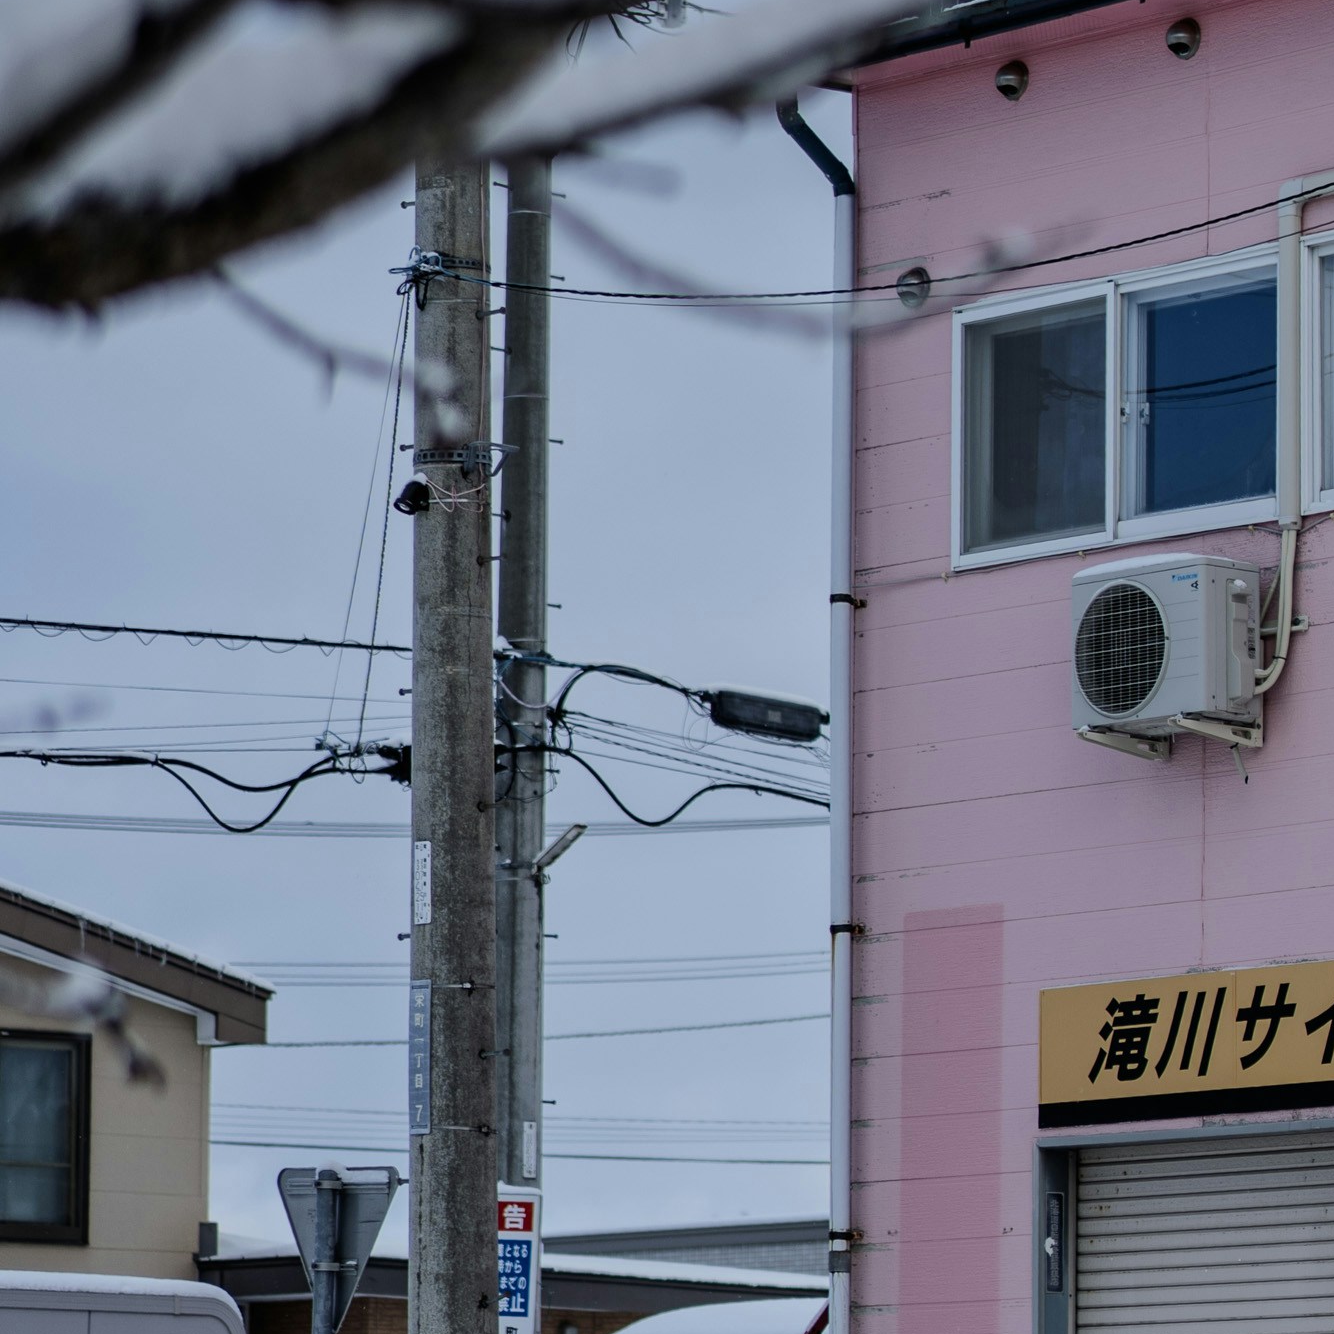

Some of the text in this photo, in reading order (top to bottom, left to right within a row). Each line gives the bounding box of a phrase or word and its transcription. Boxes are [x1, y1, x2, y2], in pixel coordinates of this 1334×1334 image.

[414, 993, 425, 1089] 栄町一丁目
